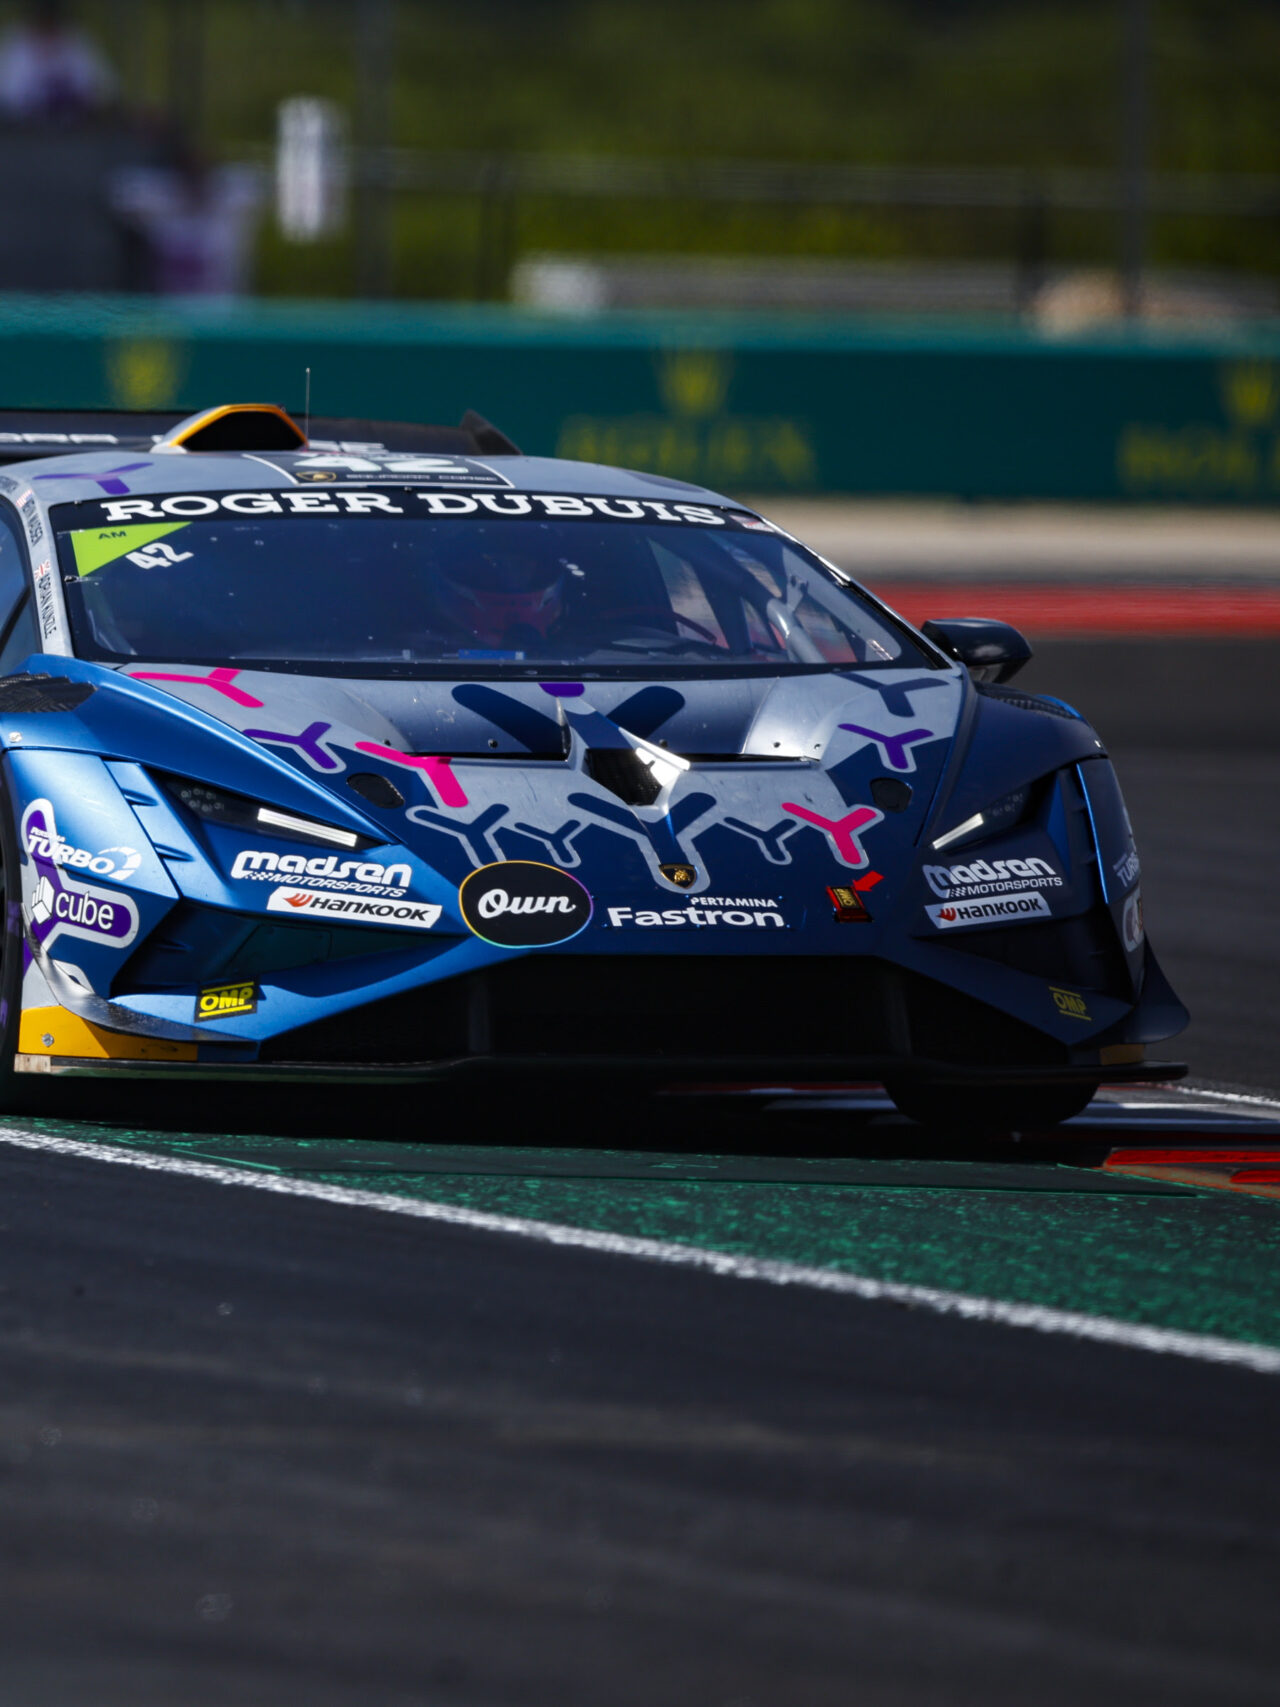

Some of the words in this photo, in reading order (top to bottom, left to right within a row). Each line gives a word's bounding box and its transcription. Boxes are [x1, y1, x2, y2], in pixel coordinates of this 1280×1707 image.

[294, 456, 469, 473] 42
[100, 492, 404, 521] ROGER
[417, 493, 726, 526] DUBUIS
[98, 530, 127, 540] AM
[125, 542, 194, 570] 42
[230, 851, 413, 888] madsen
[269, 873, 408, 898] MOTORSPORTS
[967, 877, 1064, 896] MOTORSPORTS
[55, 891, 115, 930] cube
[477, 888, 577, 919] Own
[690, 896, 779, 908] PERTAMINA
[607, 907, 785, 928] Fastron
[200, 987, 254, 1012] OMP
